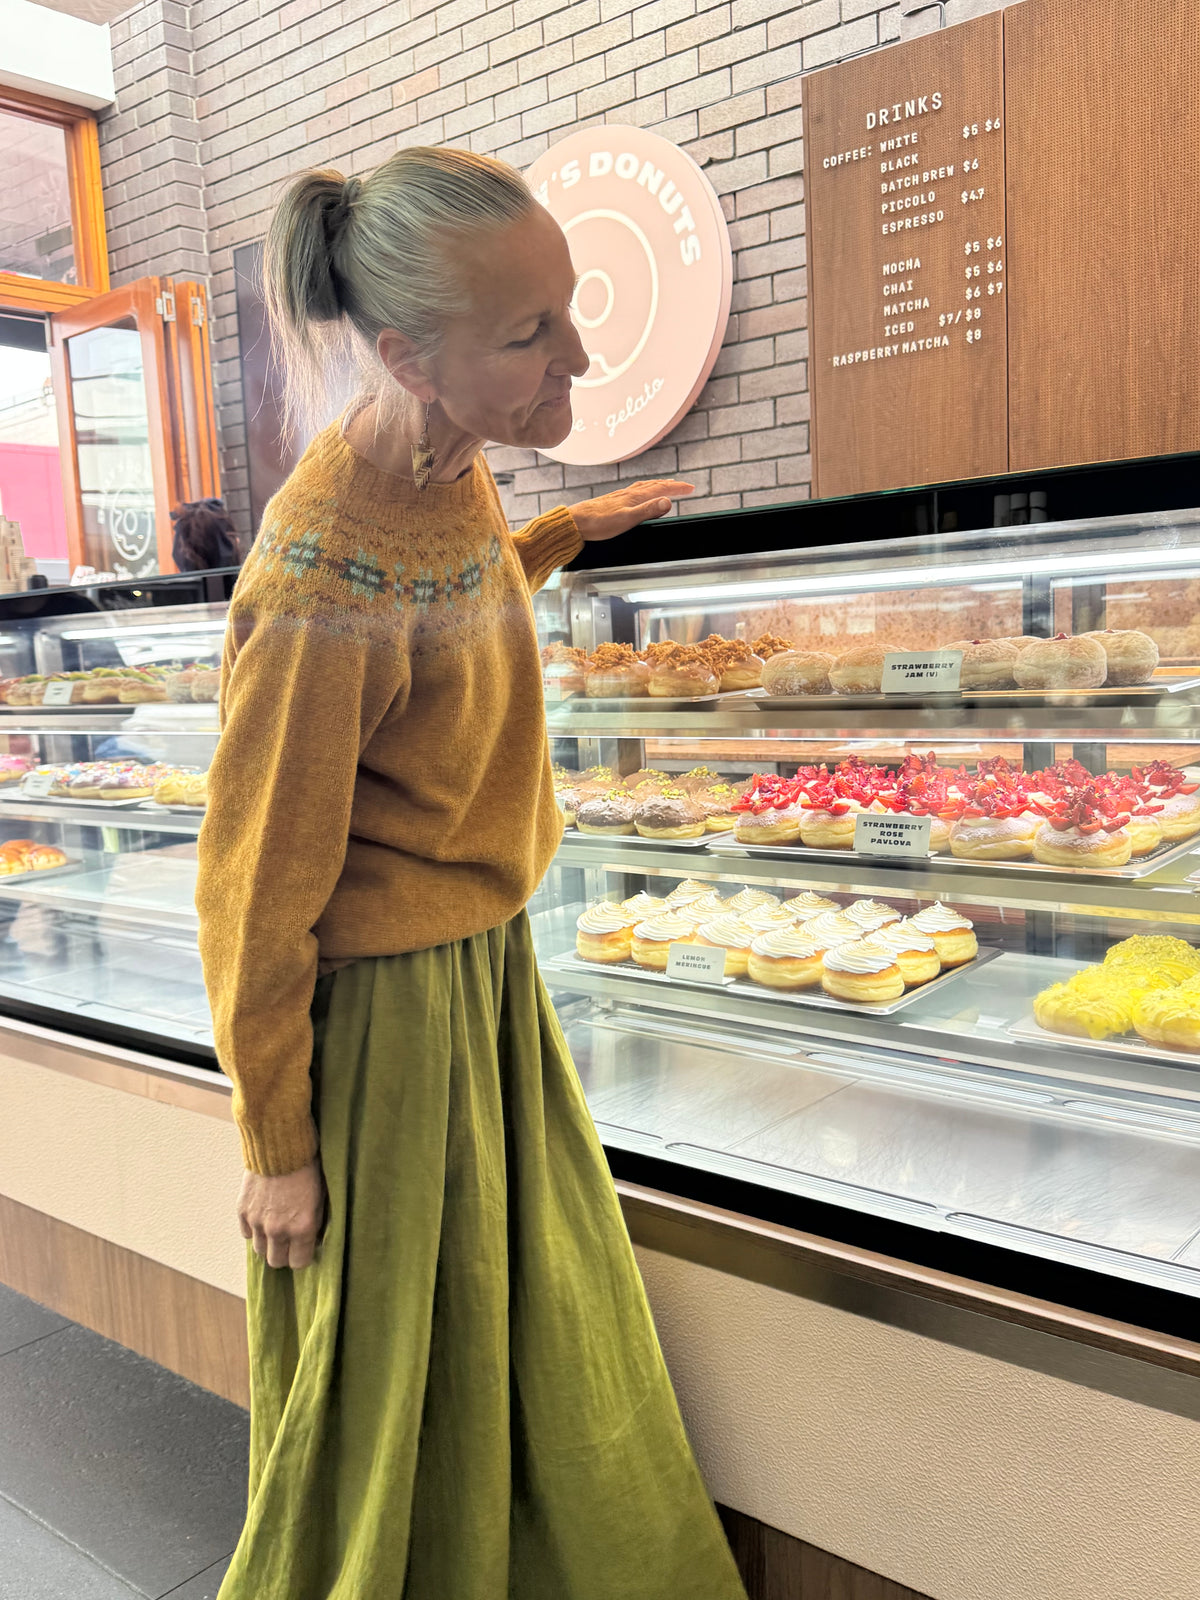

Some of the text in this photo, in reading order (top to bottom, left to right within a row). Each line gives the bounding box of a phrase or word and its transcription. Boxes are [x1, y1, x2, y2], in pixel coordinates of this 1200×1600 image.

[867, 92, 943, 130] DRINKS
[823, 117, 1001, 169] COFFEE: WHITE $5 $6
[880, 153, 919, 174] BLACK
[880, 158, 979, 194] BATCH BREW $6
[589, 151, 702, 267] DONUTS
[881, 190, 936, 215] PICCOLO
[882, 210, 944, 235] ESPRESSO
[882, 235, 1003, 276] MOCHA $5 $6
[883, 260, 1003, 297] CHAI $5 $6
[883, 281, 1003, 317] MATCHA $6 $7
[884, 321, 915, 337] ICED
[832, 328, 982, 367] RASPBERRY MATCHA $8
[605, 377, 665, 438] gelato
[891, 662, 955, 671] STRAWBERRY
[863, 821, 924, 831] STRAWBERRY
[879, 830, 904, 838] ROSE
[870, 838, 912, 847] PAVLOVA
[682, 954, 706, 962] LEMON
